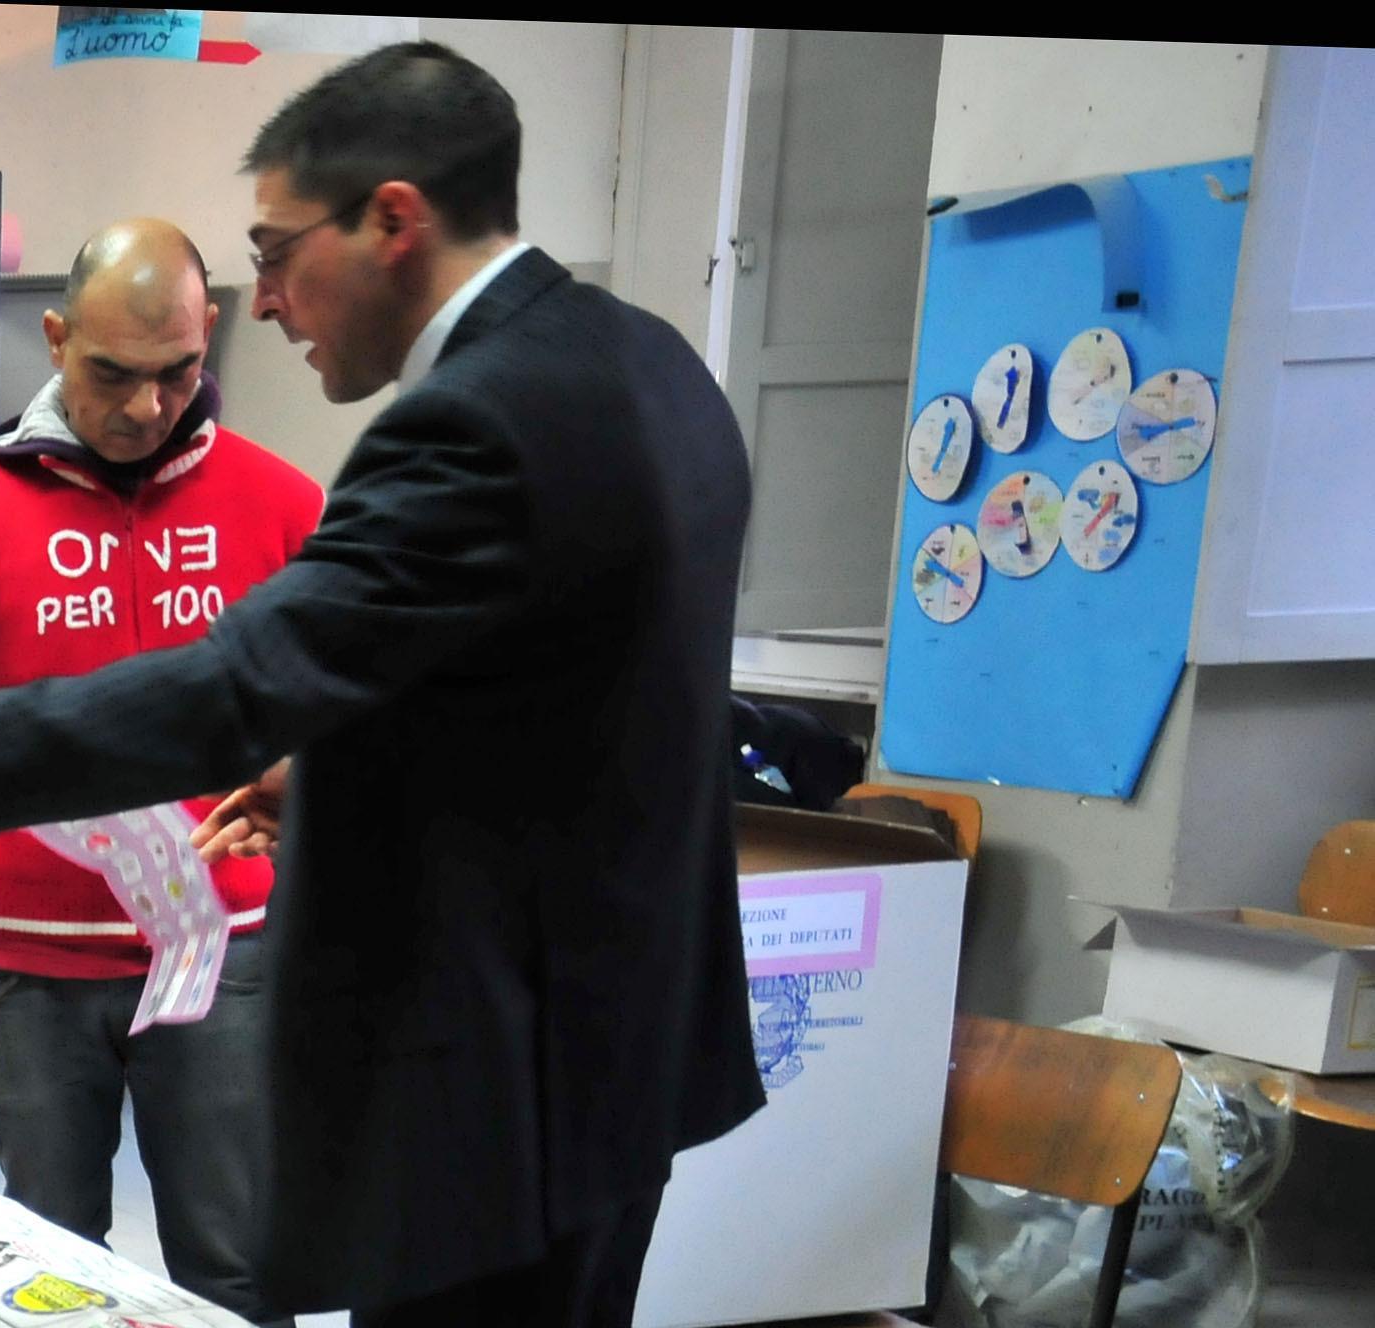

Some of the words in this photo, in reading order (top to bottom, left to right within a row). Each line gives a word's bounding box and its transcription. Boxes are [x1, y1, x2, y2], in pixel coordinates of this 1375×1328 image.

[64, 26, 171, 60] L'uomo
[36, 585, 116, 636] PER
[151, 583, 225, 629] 100
[741, 909, 788, 924] EZIONE
[761, 929, 783, 947] DEI
[790, 928, 853, 945] DEPUTATI
